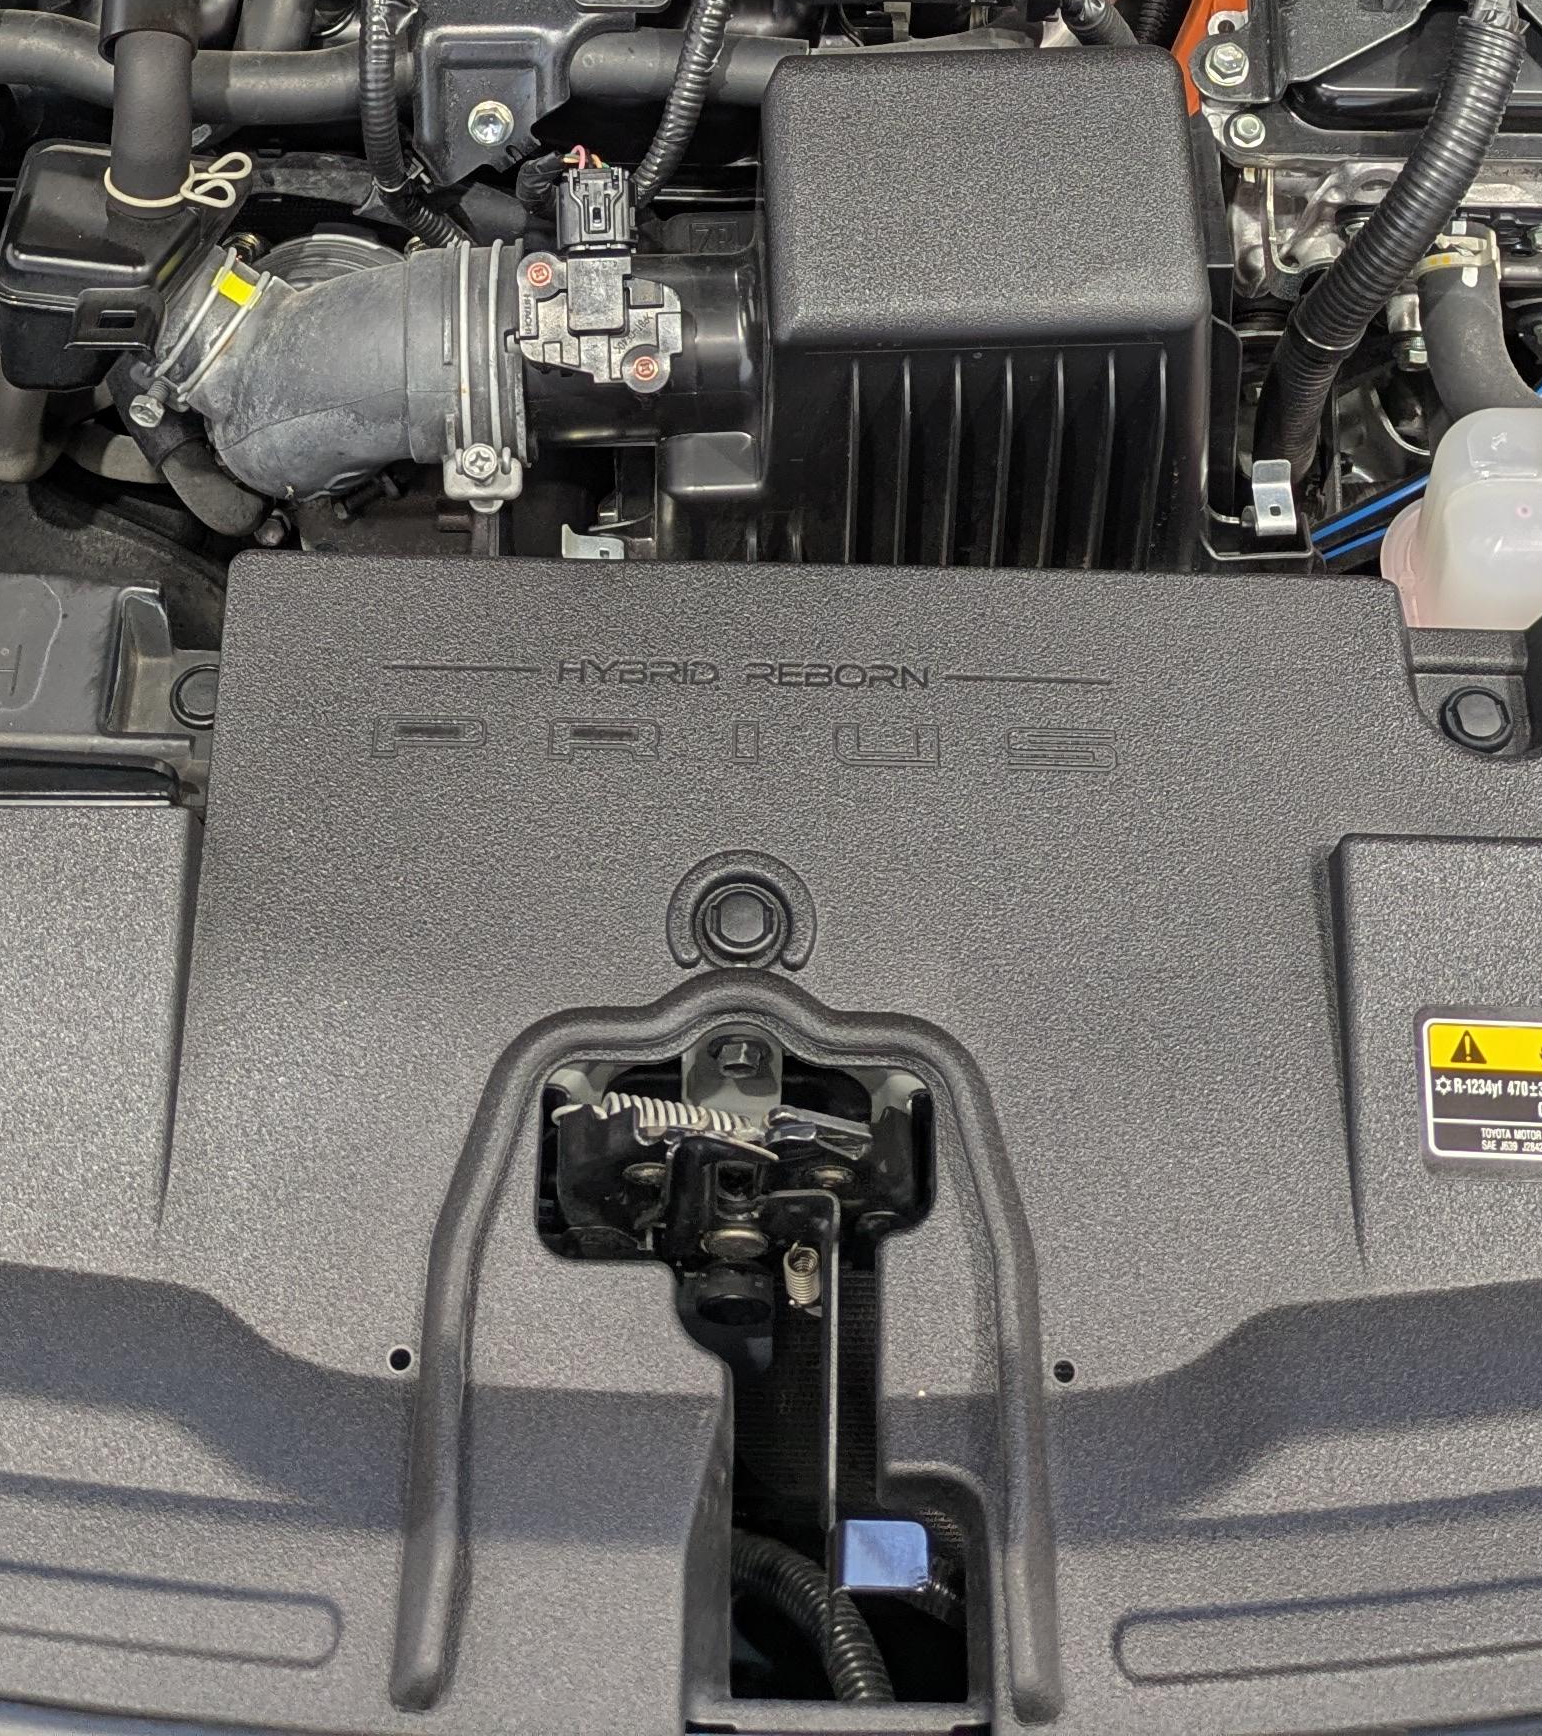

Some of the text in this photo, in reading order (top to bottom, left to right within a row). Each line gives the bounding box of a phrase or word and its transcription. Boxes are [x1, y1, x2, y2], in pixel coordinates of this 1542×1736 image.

[522, 293, 532, 336] HITACHI
[557, 661, 930, 690] HYBRID REBORN
[371, 714, 1119, 772] PRIUS
[1454, 1078, 1503, 1099] R-1234yf
[1481, 1128, 1512, 1139] TOYOTA
[1514, 1129, 1542, 1140] MOTOR
[1481, 1140, 1497, 1150] SAE
[1500, 1140, 1518, 1151] J639
